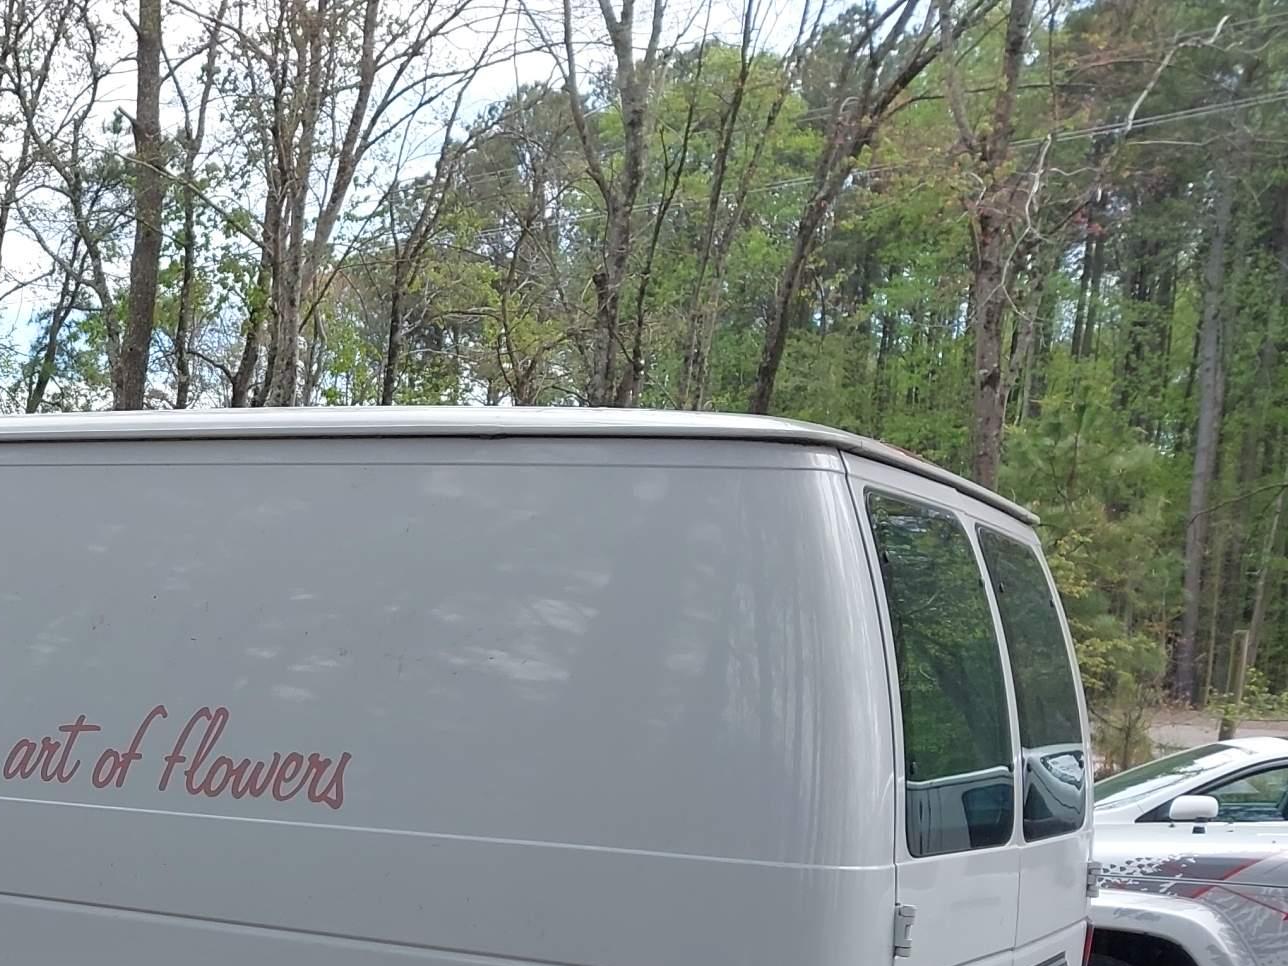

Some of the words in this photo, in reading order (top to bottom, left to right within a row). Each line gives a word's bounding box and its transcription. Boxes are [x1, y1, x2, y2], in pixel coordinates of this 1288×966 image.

[2, 714, 101, 783] art
[91, 704, 168, 789] of
[158, 706, 352, 810] flowers
